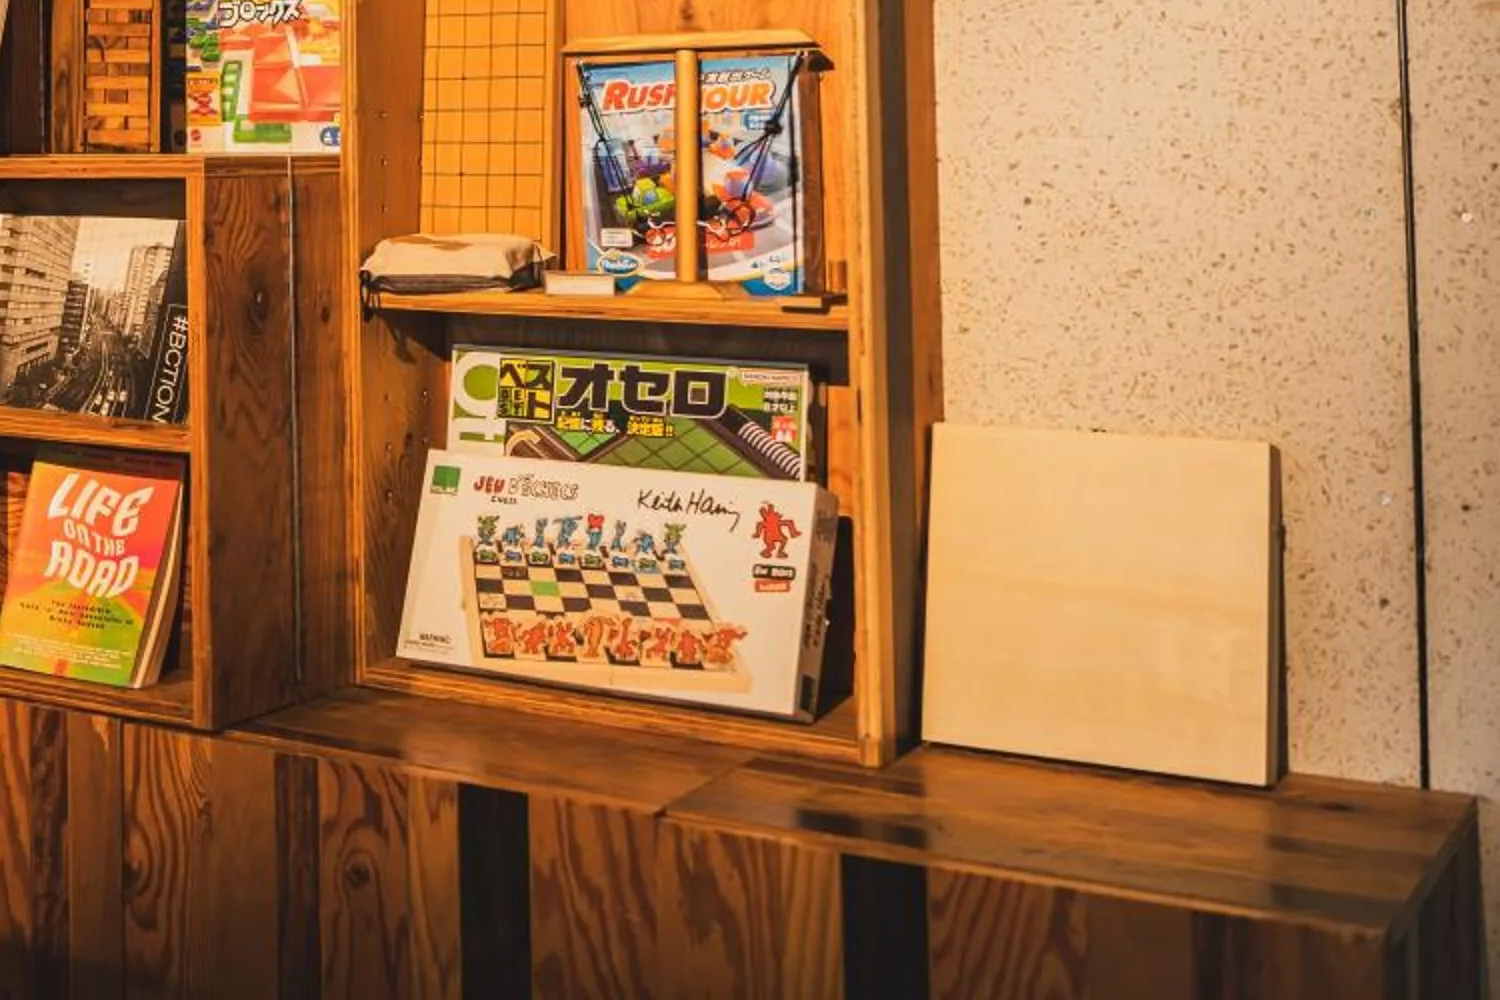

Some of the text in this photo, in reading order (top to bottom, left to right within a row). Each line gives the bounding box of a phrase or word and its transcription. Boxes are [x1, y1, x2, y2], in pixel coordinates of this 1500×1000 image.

[700, 82, 772, 110] OUR
[560, 363, 728, 418] オセロ
[473, 475, 505, 494] JEU
[637, 488, 682, 513] Keith
[47, 472, 155, 537] LIFE
[63, 518, 126, 556] ON THE
[44, 540, 140, 600] ROAD
